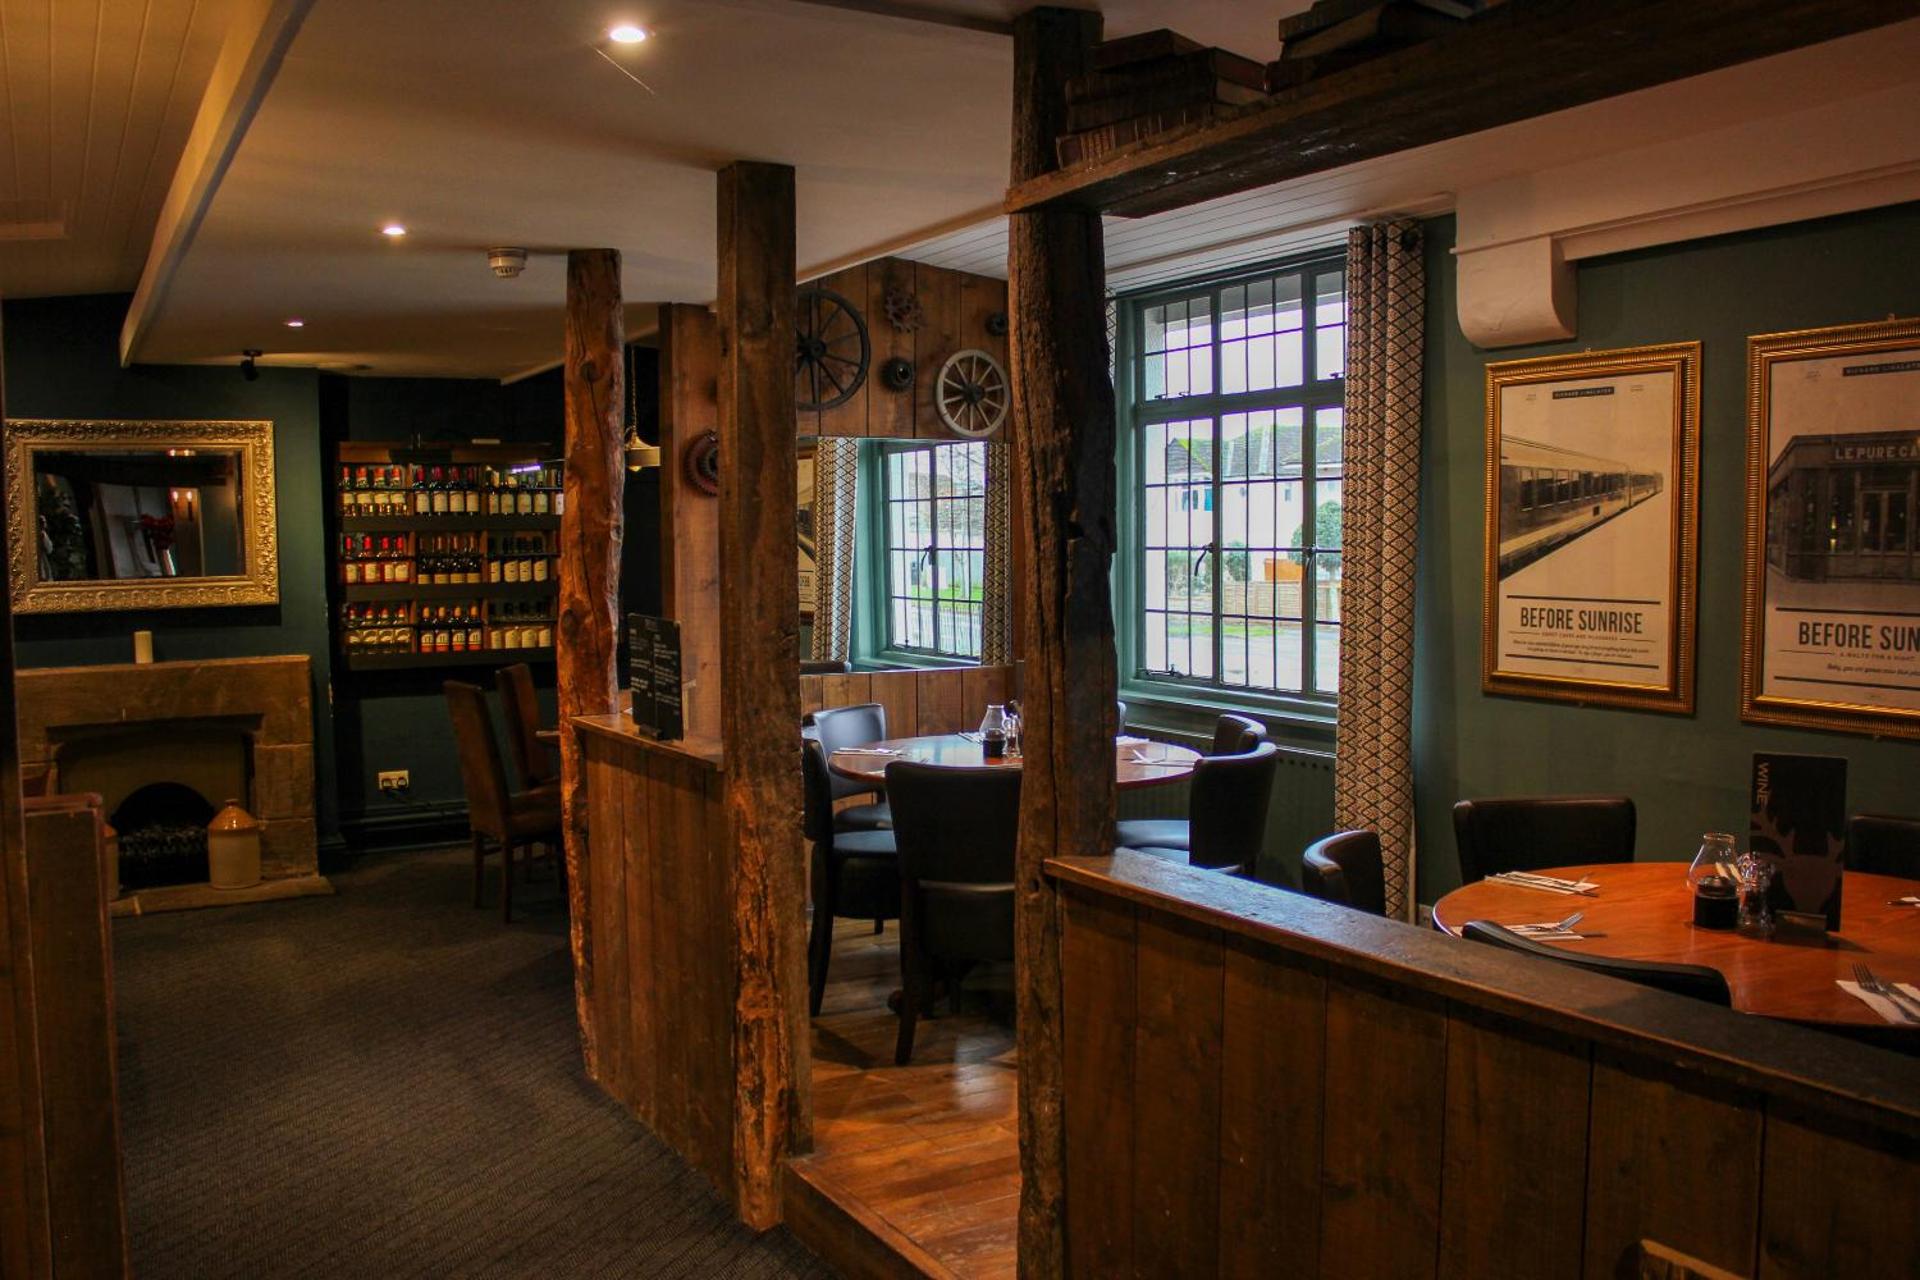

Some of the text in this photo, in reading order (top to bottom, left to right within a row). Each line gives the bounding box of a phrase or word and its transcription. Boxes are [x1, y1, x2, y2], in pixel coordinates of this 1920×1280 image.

[1520, 607, 1642, 634] BEFORE SUNRISE
[1798, 621, 1920, 652] BEFORE SUN
[1757, 762, 1769, 805] WINE
